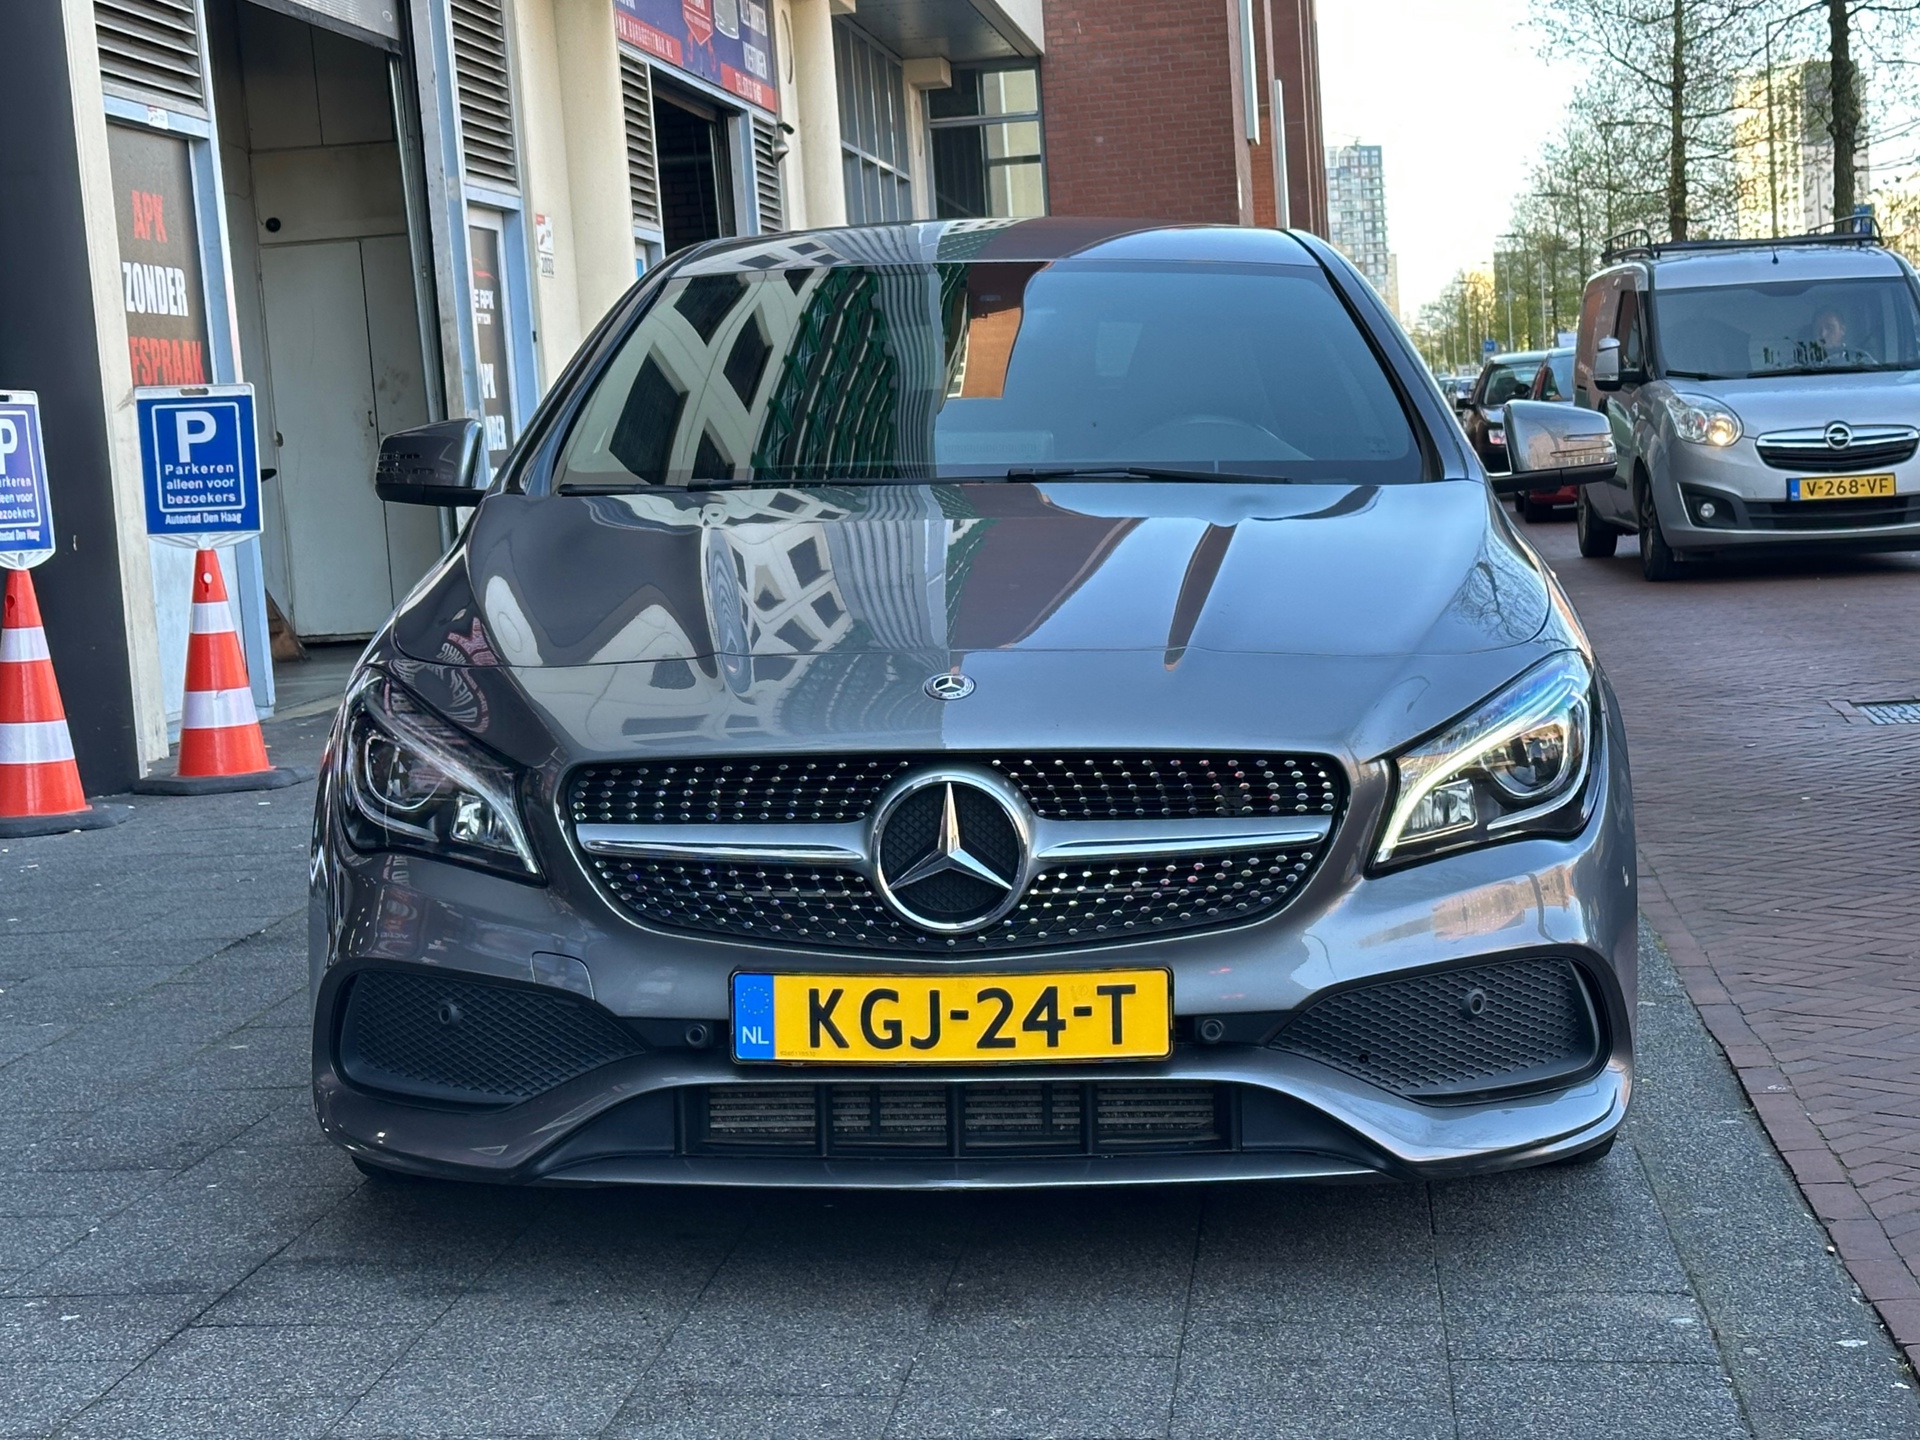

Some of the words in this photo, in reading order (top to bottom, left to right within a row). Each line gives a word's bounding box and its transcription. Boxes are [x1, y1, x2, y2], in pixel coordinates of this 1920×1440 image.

[131, 189, 168, 243] APK
[121, 261, 189, 317] ZONDER
[128, 336, 206, 385] FSPRAAK
[0, 418, 18, 475] P
[175, 410, 217, 464] P
[164, 463, 235, 476] Parkeren
[0, 475, 32, 488] rkeren
[166, 478, 204, 490] alleen
[206, 478, 236, 489] voor
[1806, 478, 1889, 497] V-268-VF
[0, 493, 15, 504] een
[16, 492, 34, 503] voor
[167, 492, 236, 505] bezoekers
[0, 507, 36, 519] ezoekers
[165, 512, 202, 525] Autostad
[202, 512, 219, 523] Den
[220, 511, 242, 524] Haag
[808, 985, 1137, 1051] KGJ-24-T
[742, 1026, 770, 1045] NL
